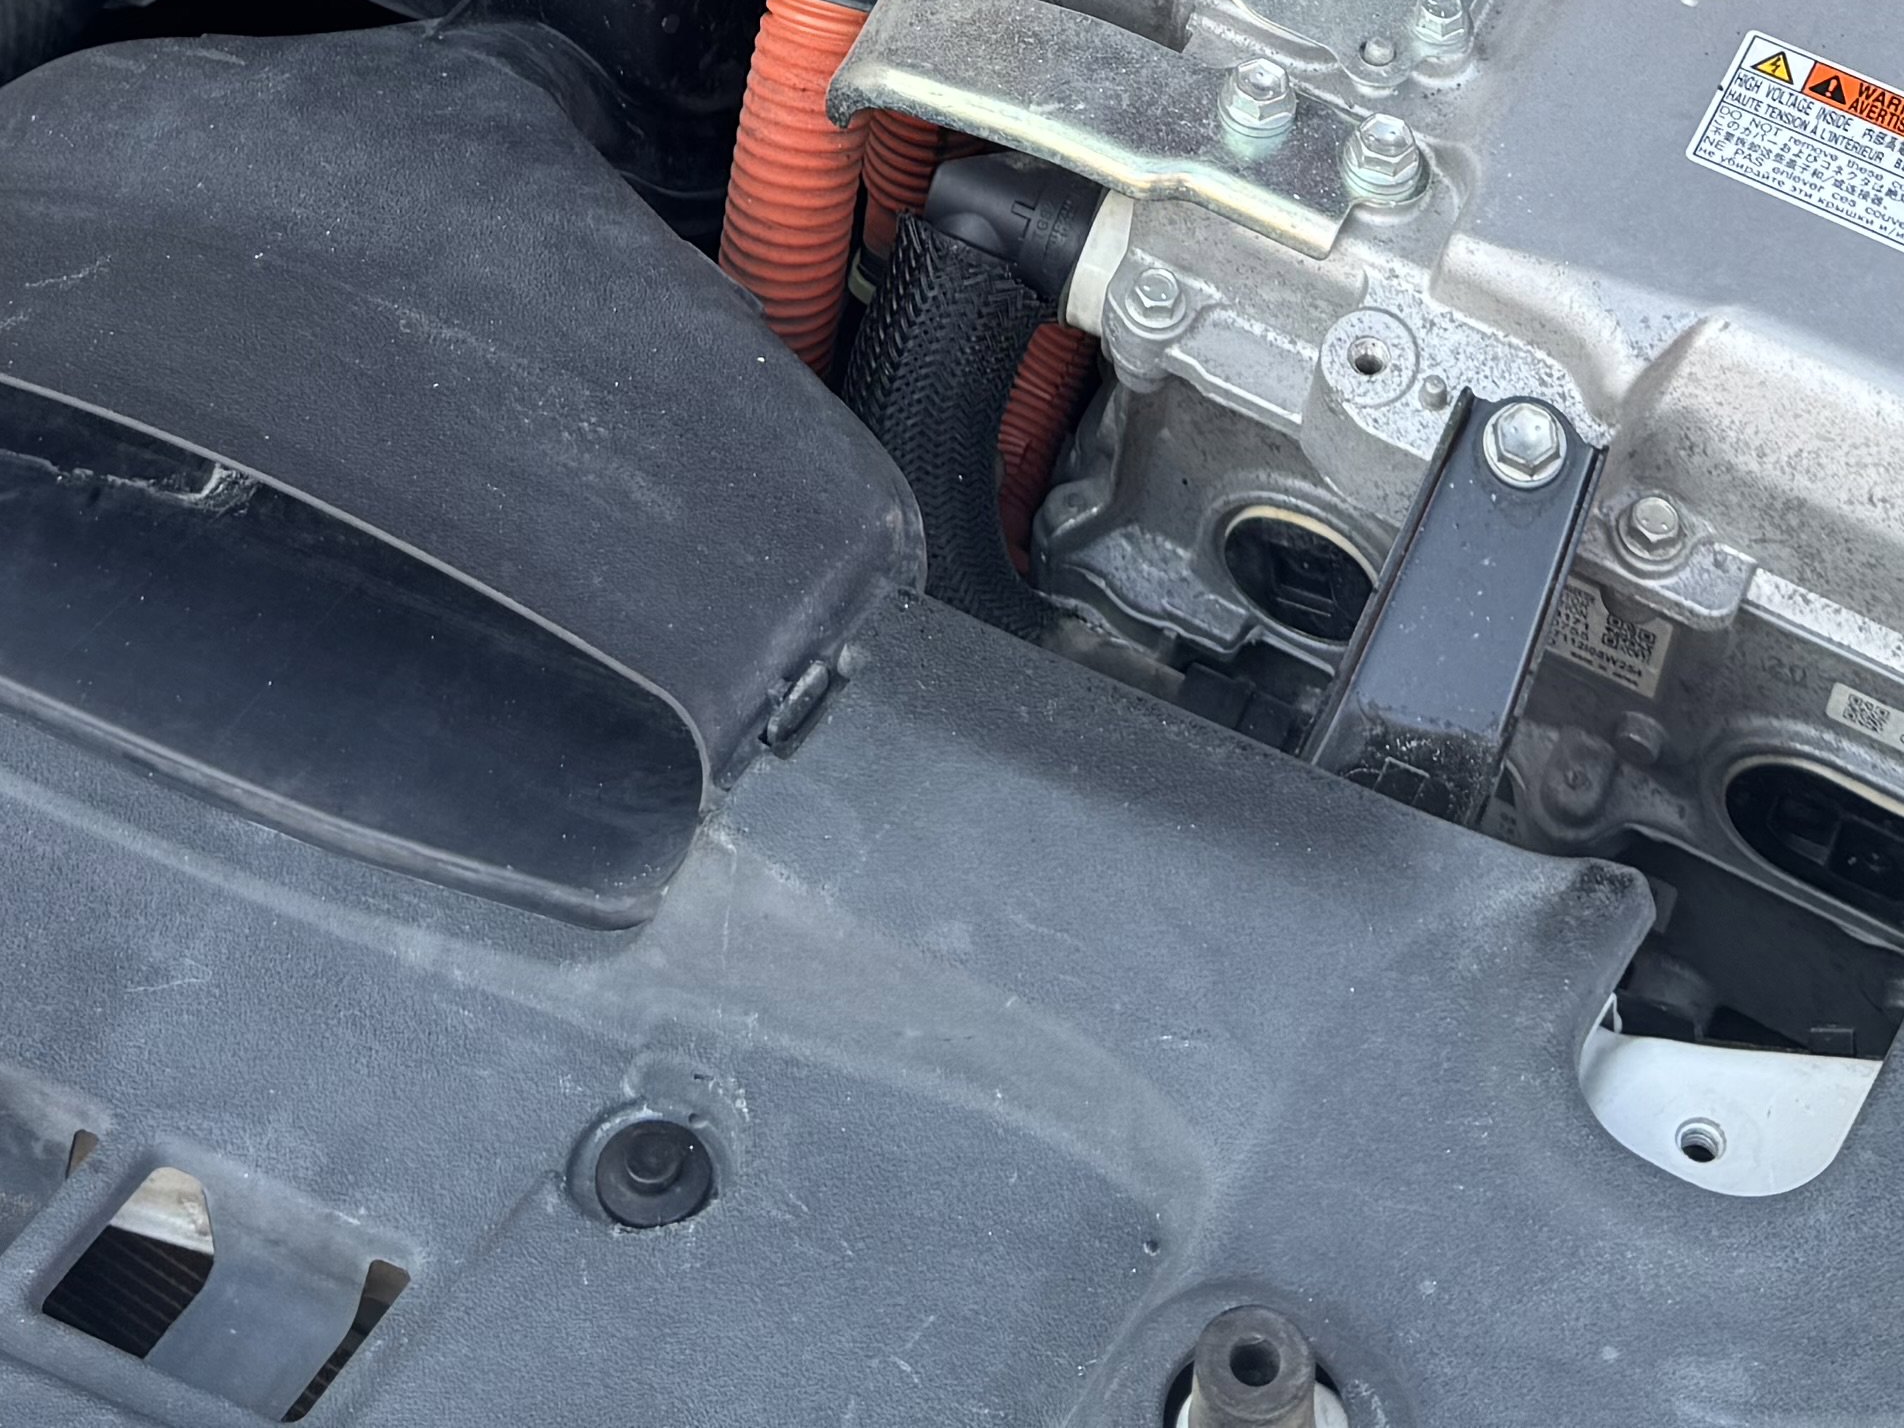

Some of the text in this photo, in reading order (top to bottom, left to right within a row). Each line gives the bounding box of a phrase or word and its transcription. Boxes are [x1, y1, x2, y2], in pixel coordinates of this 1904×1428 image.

[1725, 84, 1765, 112] HAUTE
[1763, 101, 1811, 132] TENSION
[1732, 69, 1764, 94] HIGH
[1762, 82, 1816, 117] VOLTAGE
[1813, 104, 1855, 134] INSIDE
[1701, 132, 1728, 152] NE
[1731, 146, 1766, 169] PAS
[1769, 162, 1826, 196] enlever
[1829, 188, 1859, 210] ces
[1718, 103, 1744, 121] DO
[1748, 116, 1783, 138] NOT
[1786, 133, 1840, 163] remove
[1844, 158, 1885, 183] these
[1697, 143, 1717, 159] не
[1718, 152, 1787, 190] убирайте
[1787, 183, 1814, 202] эти
[1815, 195, 1875, 229] крышки
